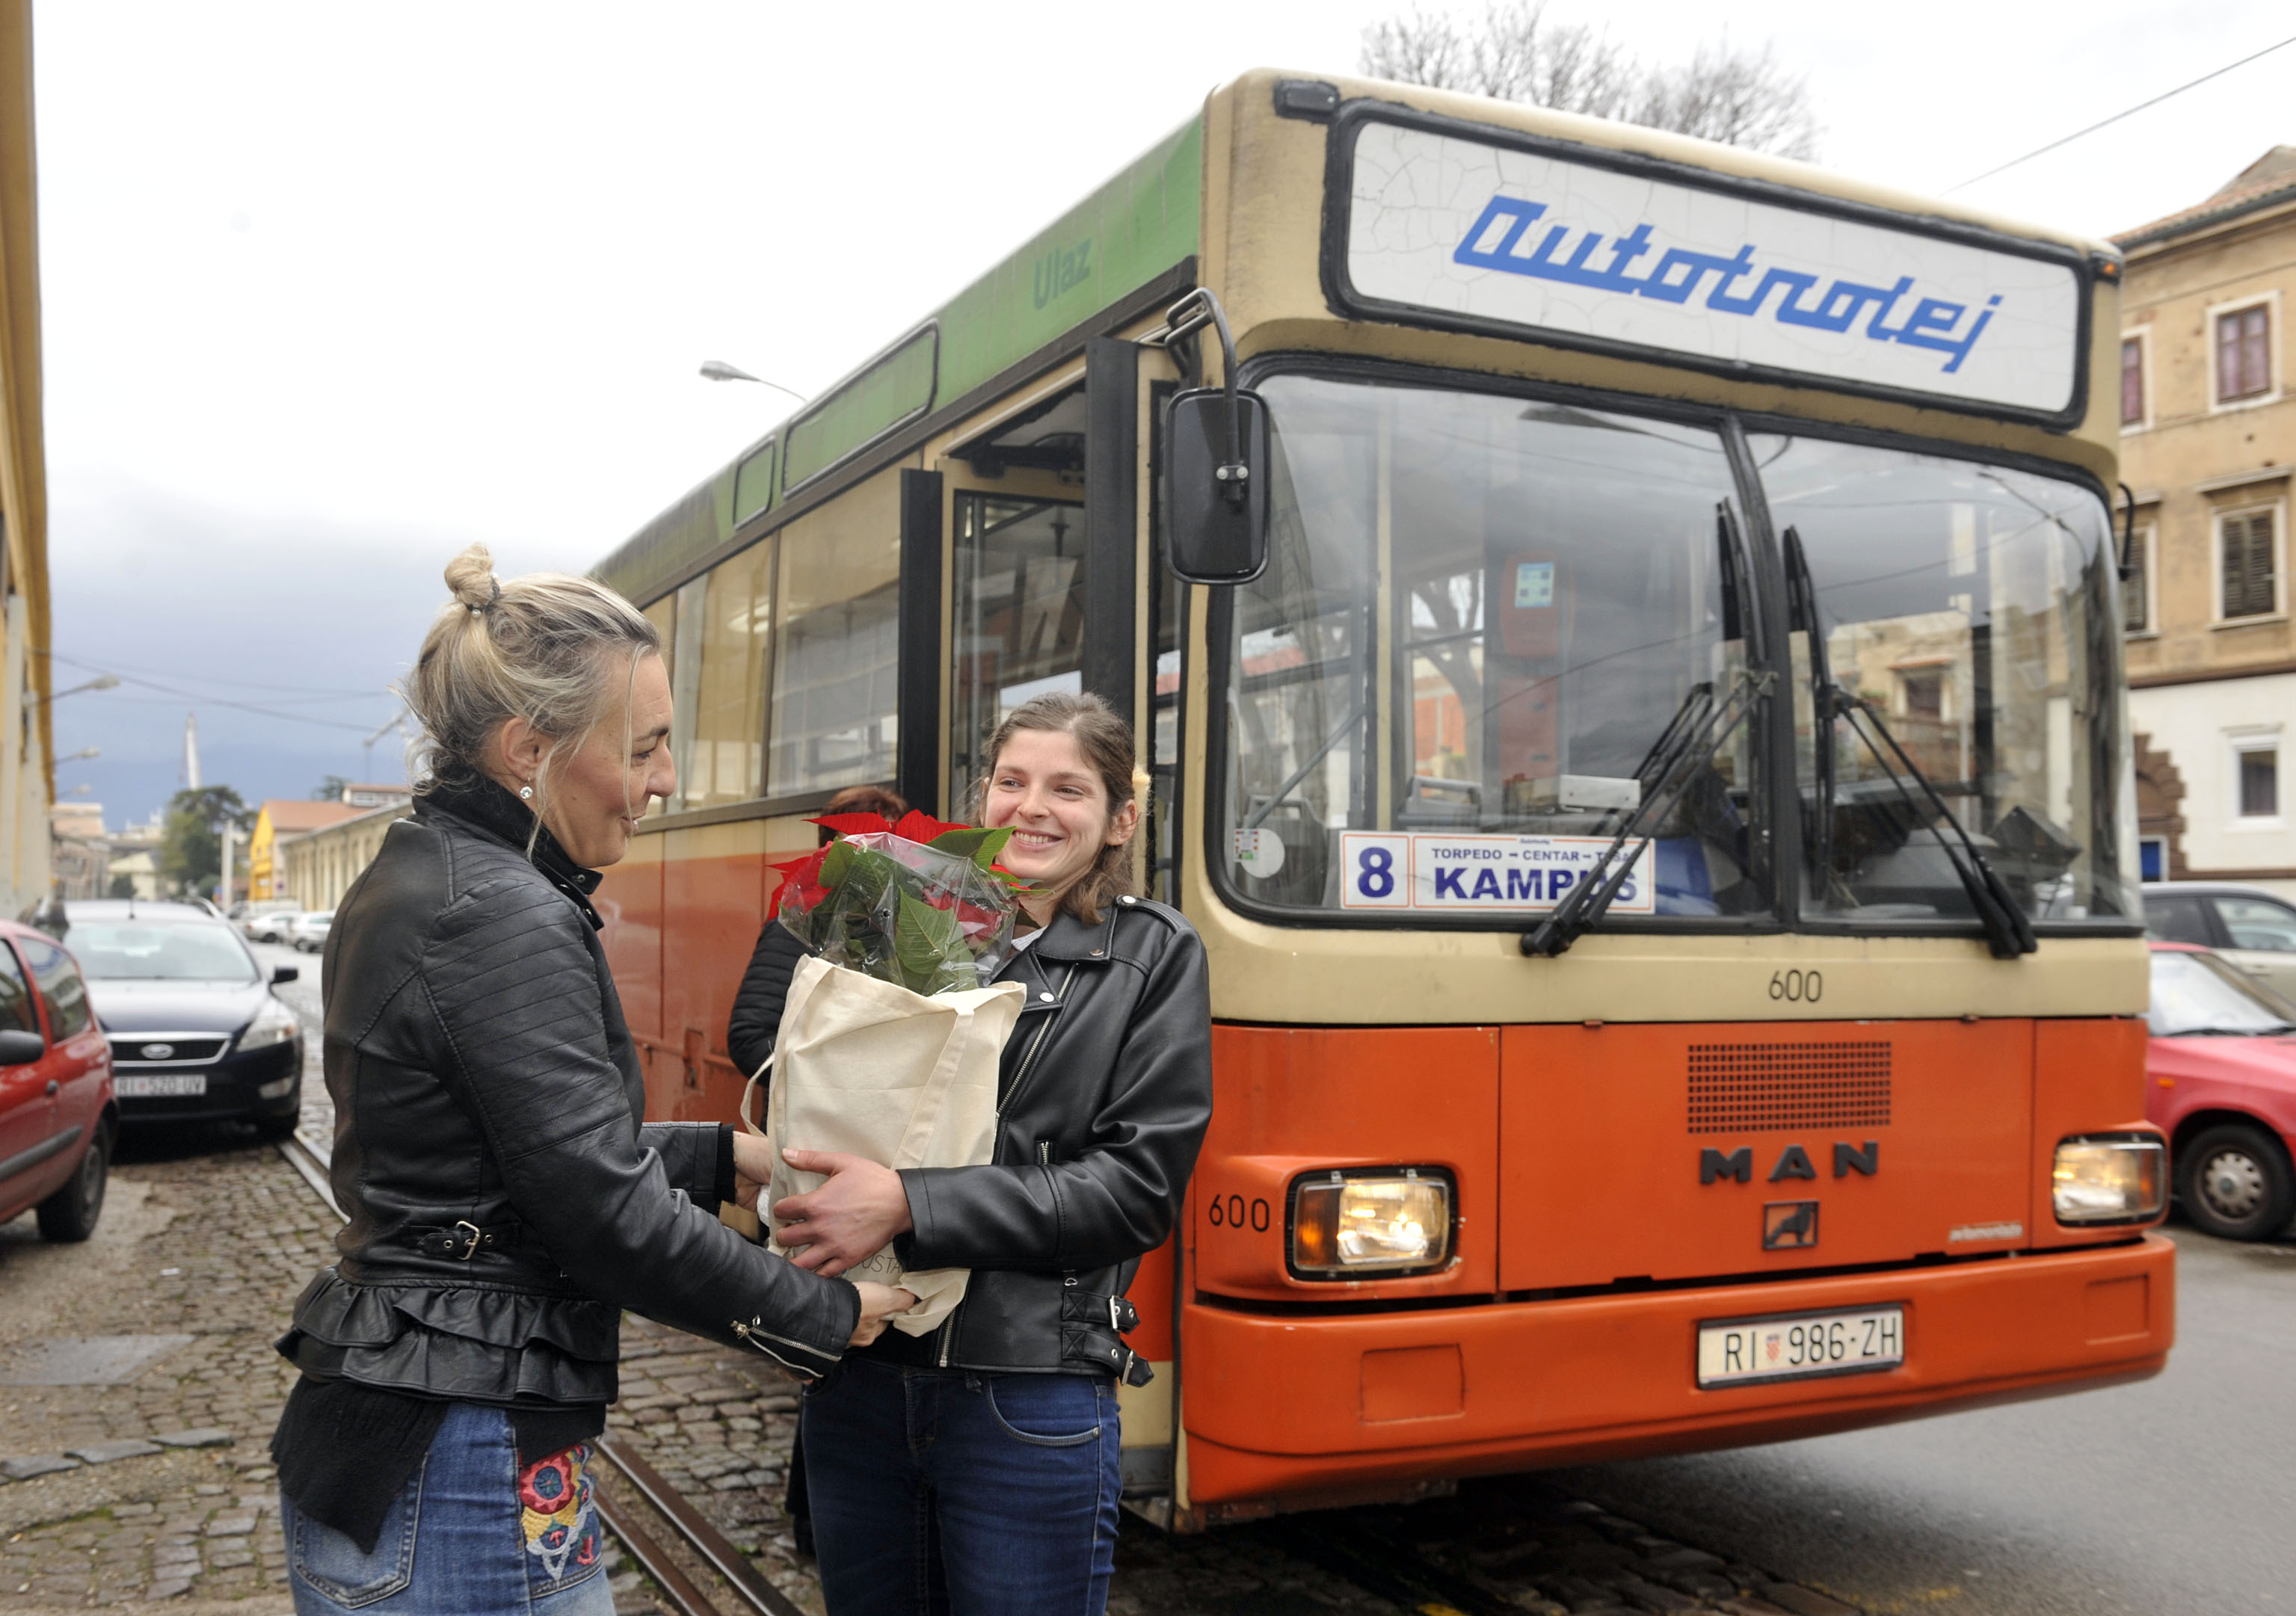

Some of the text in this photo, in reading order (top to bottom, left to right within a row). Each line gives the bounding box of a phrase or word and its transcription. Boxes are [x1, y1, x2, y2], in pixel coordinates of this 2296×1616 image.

[1033, 237, 1092, 310] Ulaz
[1357, 846, 1394, 898] 8
[1431, 848, 1503, 860] TORPEDO
[1522, 849, 1580, 862] CENTAR
[1769, 969, 1822, 1002] 600
[1699, 1139, 1879, 1185] MAN
[1209, 1194, 1270, 1232] 600
[1726, 1330, 1756, 1372] RI
